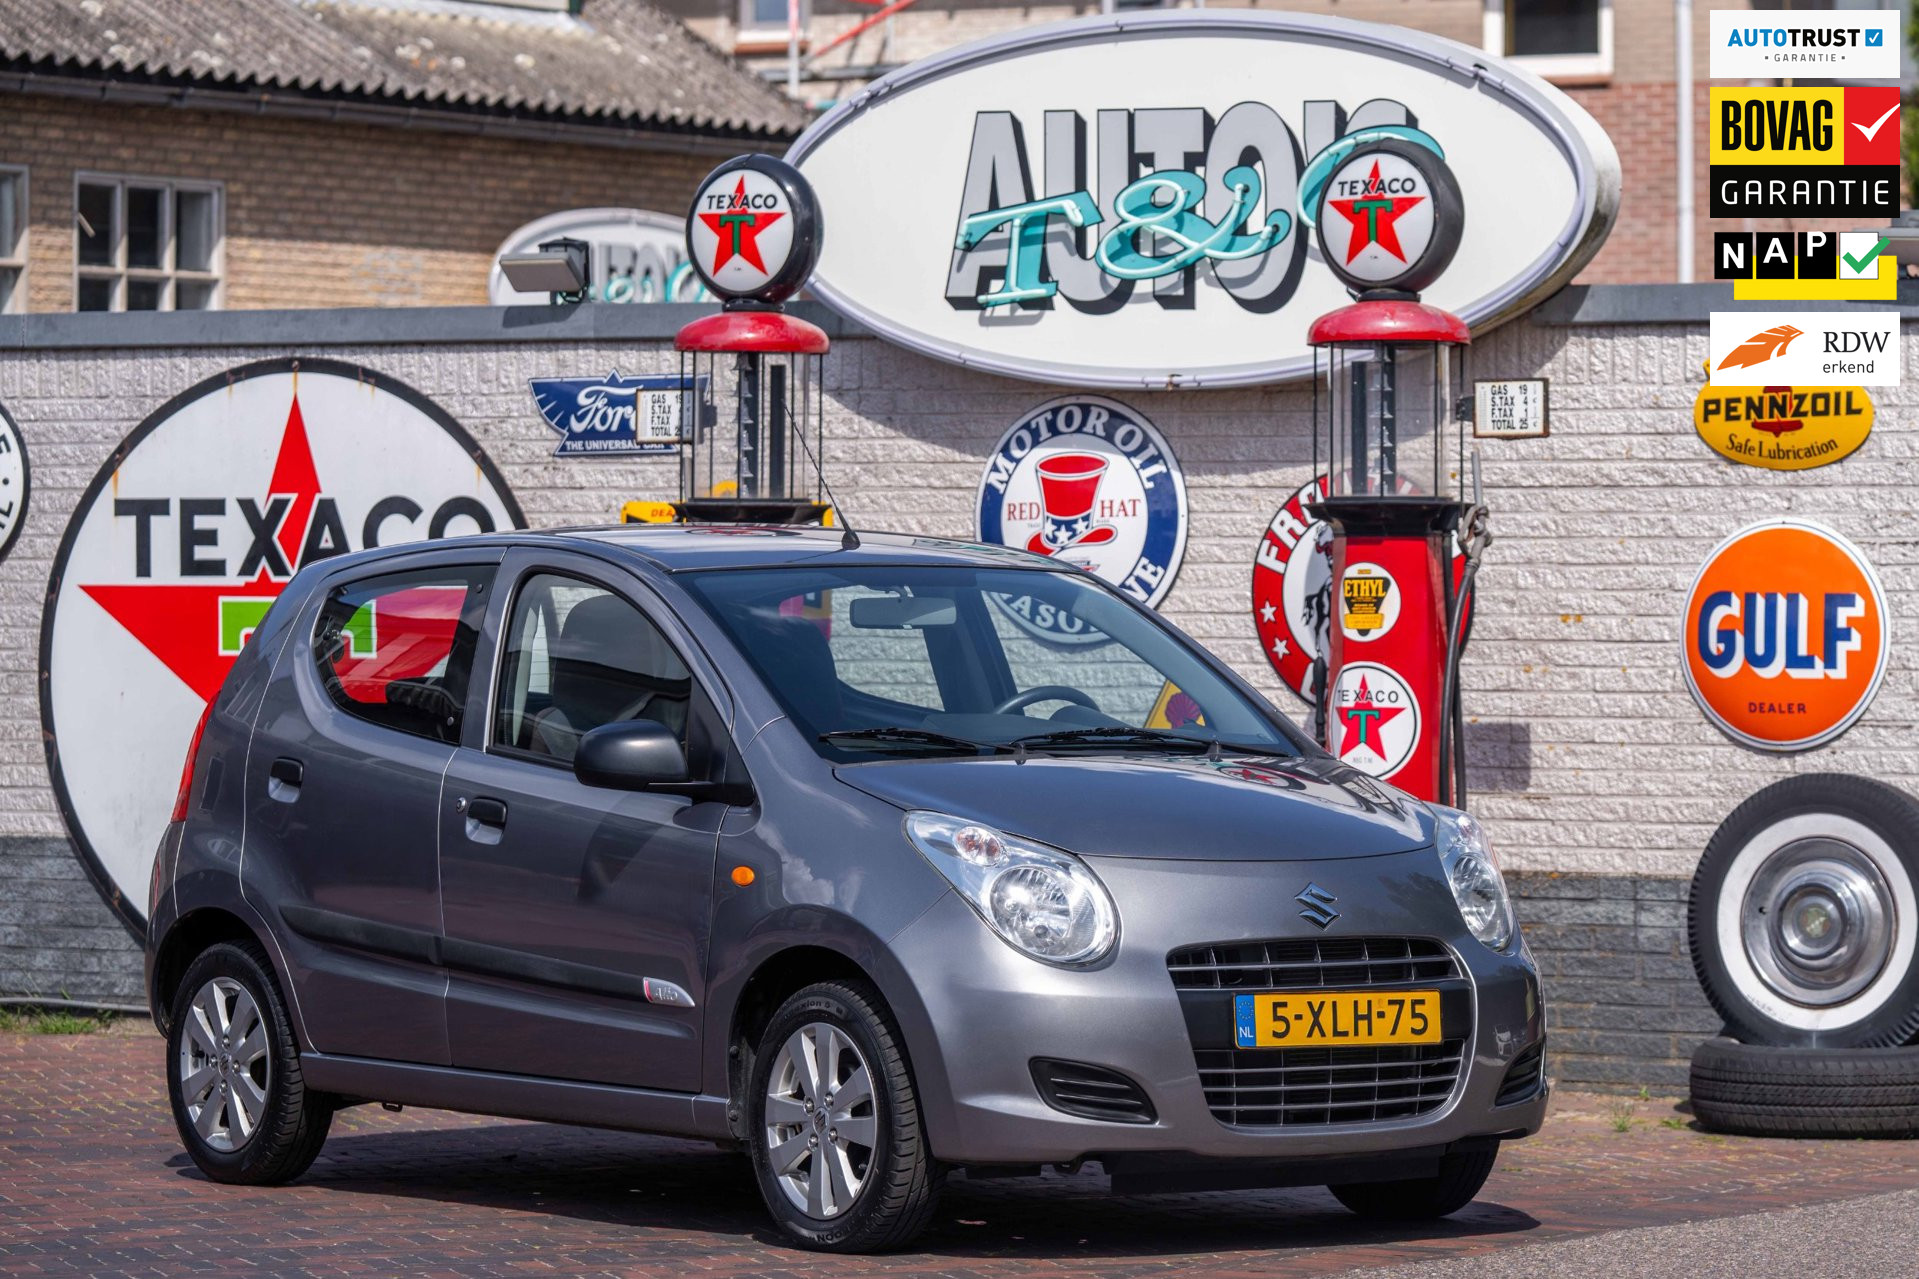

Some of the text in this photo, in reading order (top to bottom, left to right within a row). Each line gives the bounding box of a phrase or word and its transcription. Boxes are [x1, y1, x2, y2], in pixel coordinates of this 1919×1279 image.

[1338, 177, 1416, 197] TEXACO
[707, 194, 778, 210] TEXACO
[945, 98, 1418, 314] AUTO'
[1352, 199, 1393, 243] T
[719, 213, 756, 254] T
[651, 394, 666, 404] GAS
[1491, 384, 1528, 396] GAS 19
[570, 384, 642, 434] For
[651, 405, 672, 415] S.TAX
[1491, 396, 1528, 407] S.TAX 4
[1703, 391, 1863, 423] PENNZOIL
[651, 416, 670, 426] F.TAX
[1491, 408, 1514, 419] F.TAX
[651, 427, 672, 437] TOTAL
[1491, 418, 1529, 430] TOTAL 25
[565, 440, 584, 451] THE
[585, 438, 641, 451] UNIVERSAL
[987, 405, 1168, 495] MOTOR OIL
[1726, 433, 1838, 460] Safe Lubrication
[1007, 499, 1141, 521] RED HAT
[1344, 579, 1386, 597] ETHYL
[1698, 591, 1866, 680] GULF
[1748, 702, 1807, 715] DEALER
[1347, 710, 1379, 744] T
[1272, 999, 1429, 1039] 5-XLH-75
[1239, 1026, 1254, 1038] NL
